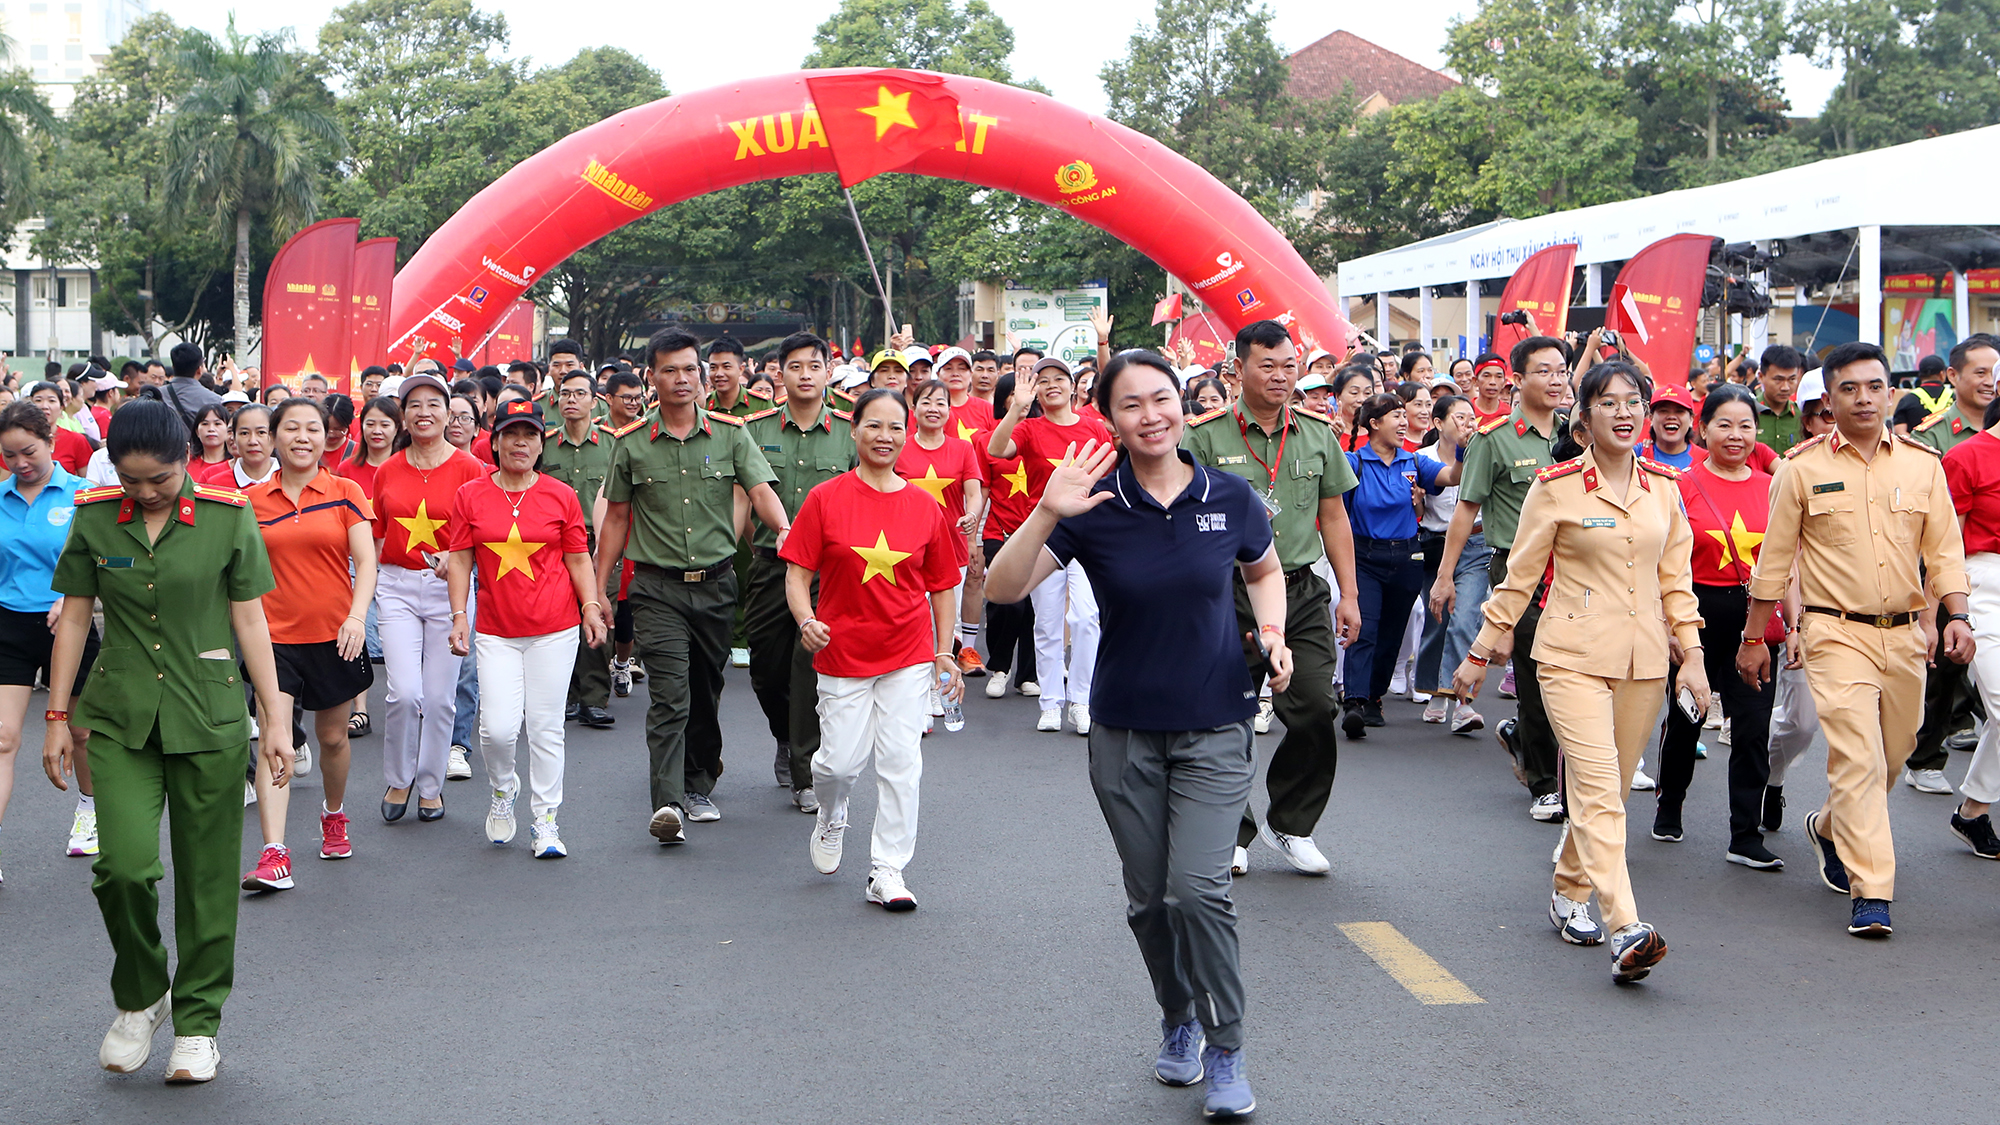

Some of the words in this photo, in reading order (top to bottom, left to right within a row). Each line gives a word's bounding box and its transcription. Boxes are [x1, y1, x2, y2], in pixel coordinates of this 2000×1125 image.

[728, 103, 829, 161] XUÂ
[583, 159, 627, 197] Nhân
[620, 184, 654, 209] Dân
[1070, 192, 1100, 206] CÔNG
[1101, 186, 1117, 199] AN
[482, 255, 531, 287] Vietcombank
[1470, 248, 1490, 269] NGÀY
[1491, 246, 1505, 271] HỘI
[1506, 245, 1520, 264] THU
[1191, 260, 1244, 290] Vietcombank
[1698, 348, 1711, 358] 10
